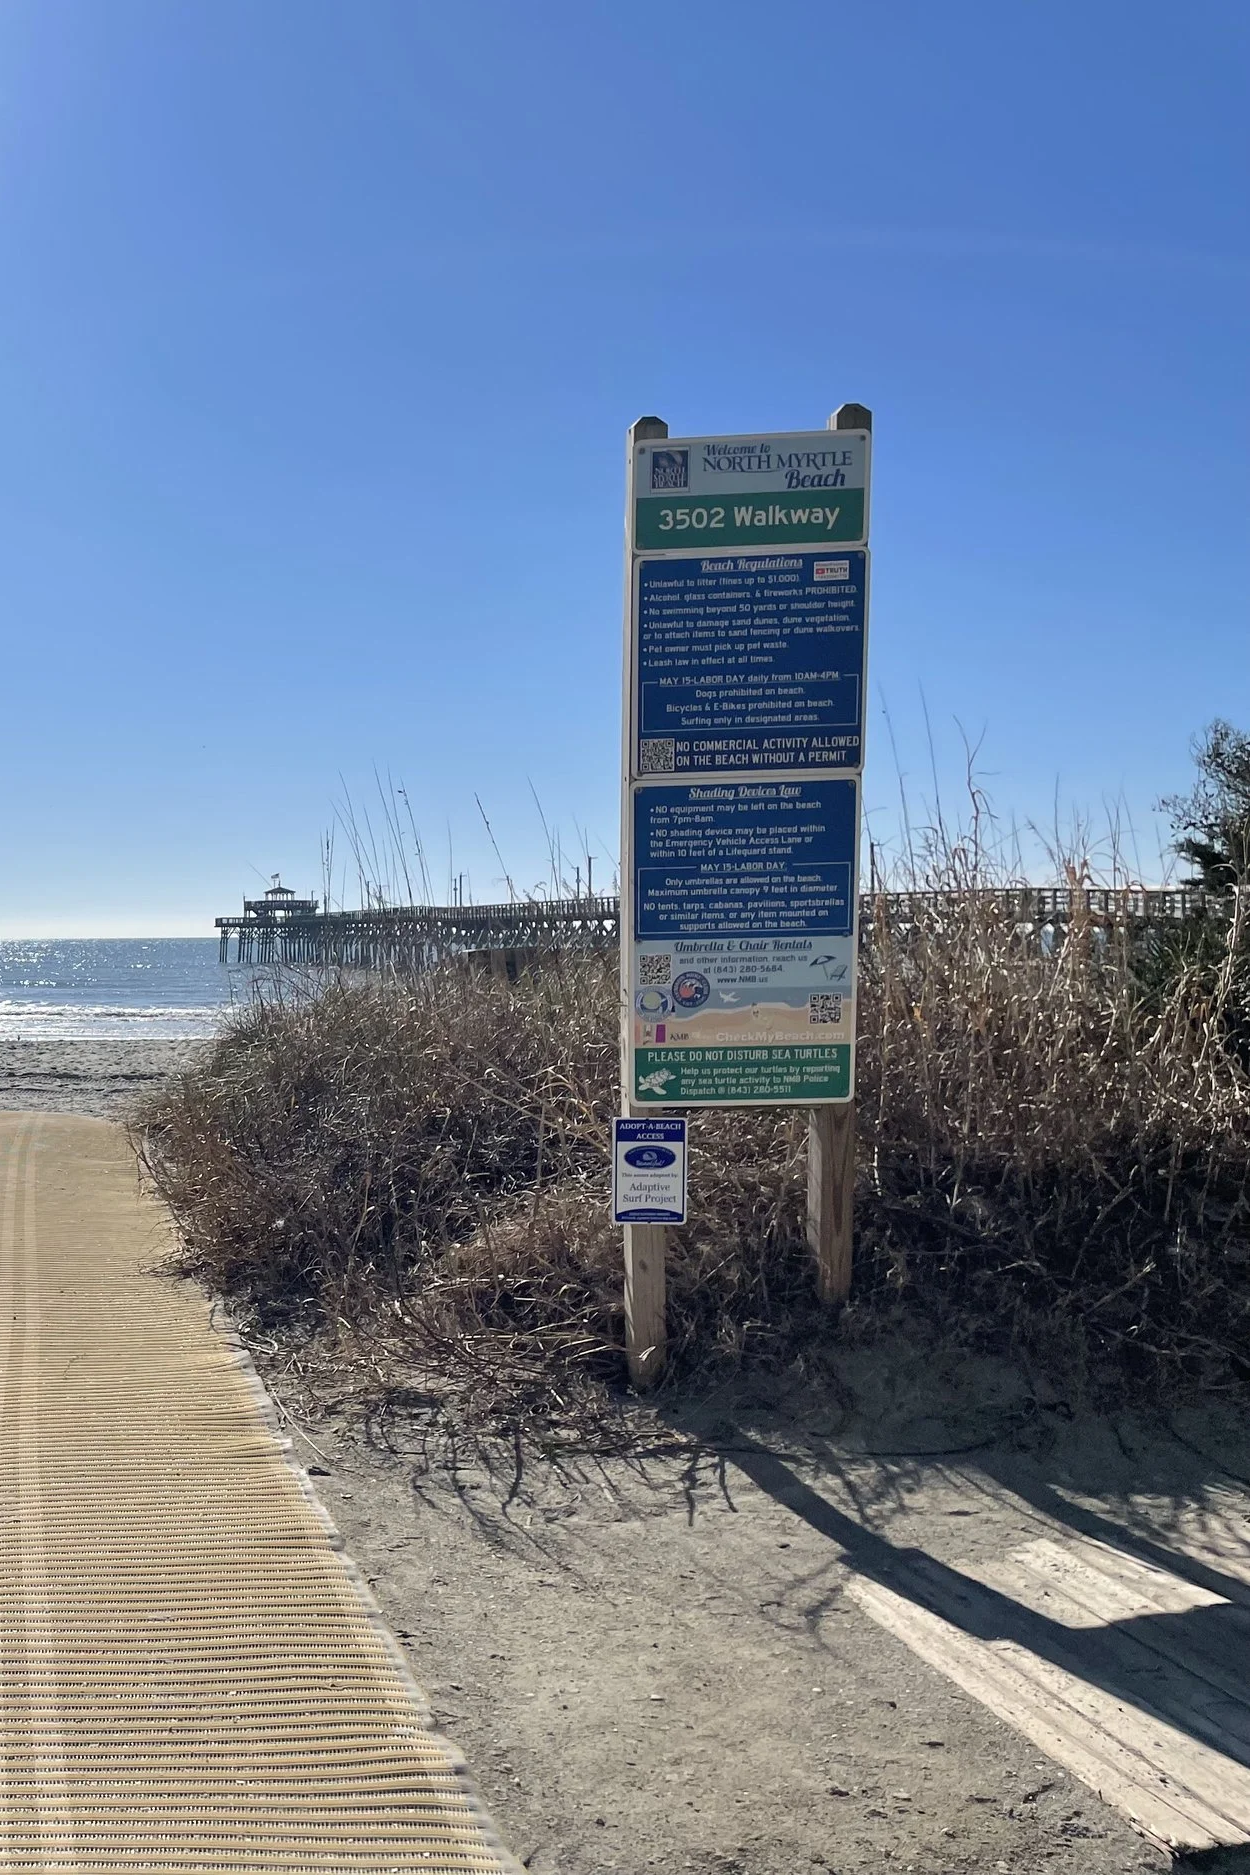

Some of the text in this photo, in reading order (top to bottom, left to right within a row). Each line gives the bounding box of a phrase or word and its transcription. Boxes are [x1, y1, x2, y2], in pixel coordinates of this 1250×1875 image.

[703, 443, 771, 456] Welcome to
[703, 451, 852, 472] NORTH MYRTLE
[785, 468, 845, 489] Beach
[658, 505, 840, 530] 3502 Walkway
[701, 557, 803, 572] Beach Regulations
[650, 580, 684, 588] Unlawful
[684, 589, 802, 602] glass fireworks
[662, 606, 703, 615] swimming
[706, 605, 736, 615] beyond
[739, 604, 750, 612] 50
[753, 604, 776, 613] yards
[791, 601, 826, 610] shoulder
[649, 616, 802, 629] Unlawful to damage sand dune
[665, 631, 689, 639] attach
[692, 630, 715, 638] items
[729, 628, 747, 636] sand
[750, 628, 780, 636] fencing
[794, 626, 813, 634] dune
[650, 645, 662, 653] Pet
[715, 643, 731, 652] pick
[747, 642, 760, 651] pet
[648, 656, 736, 667] Leash law effect at
[660, 677, 678, 685] MAY
[682, 675, 723, 684] 15-LABOR
[726, 675, 745, 683] DAY
[748, 674, 769, 683] daily
[795, 671, 839, 680] 10AM-4PM
[696, 687, 763, 699] Dogs prohibited
[666, 700, 792, 714] Bicycles E-Bikes prohibited
[681, 717, 711, 726] Surfing
[714, 717, 731, 725] only
[745, 714, 791, 724] designated
[676, 736, 859, 752] NO COMMERCIAL ACTIVITY ALLOWED
[676, 751, 847, 766] ON THE BEACH WITHOUT A PERMIT
[689, 784, 801, 800] Shading Devices Law
[670, 805, 714, 814] equipment
[716, 804, 735, 813] may
[738, 803, 748, 811] be
[751, 802, 764, 810] left
[780, 801, 793, 809] the
[650, 816, 670, 824] from
[670, 829, 702, 838] shading
[735, 828, 753, 836] may
[769, 825, 797, 835] placed
[650, 839, 663, 847] the
[666, 839, 714, 848] Emergency
[749, 837, 779, 845] Access
[650, 847, 766, 858] within 10 feet of Lifeguard
[666, 878, 683, 887] Only
[685, 877, 723, 885] umbrellas
[648, 889, 688, 897] Maximum
[690, 887, 727, 895] umbrella
[730, 887, 760, 896] canopy
[644, 899, 844, 911] NO sportsbrellas
[671, 909, 816, 920] similar any item mounted
[680, 922, 715, 930] supports
[718, 921, 749, 929] allowed
[674, 939, 813, 952] Umbrella Chair Rentals
[697, 956, 717, 964] other
[714, 966, 736, 974] (843)
[716, 1030, 844, 1043] CheckMyBeach.com
[648, 1048, 837, 1062] PLEASE DO NOT DISTURB SEA TURTLES
[714, 1066, 742, 1075] protect
[790, 1066, 800, 1075] by
[803, 1065, 840, 1073] reporting
[715, 1076, 736, 1084] turtle
[739, 1076, 770, 1085] activity
[783, 1075, 800, 1083] NMB
[803, 1074, 829, 1082] Police
[681, 1086, 750, 1096] Dispatch (843)
[630, 1183, 670, 1191] Adaptive
[623, 1194, 676, 1204] Surf Project
